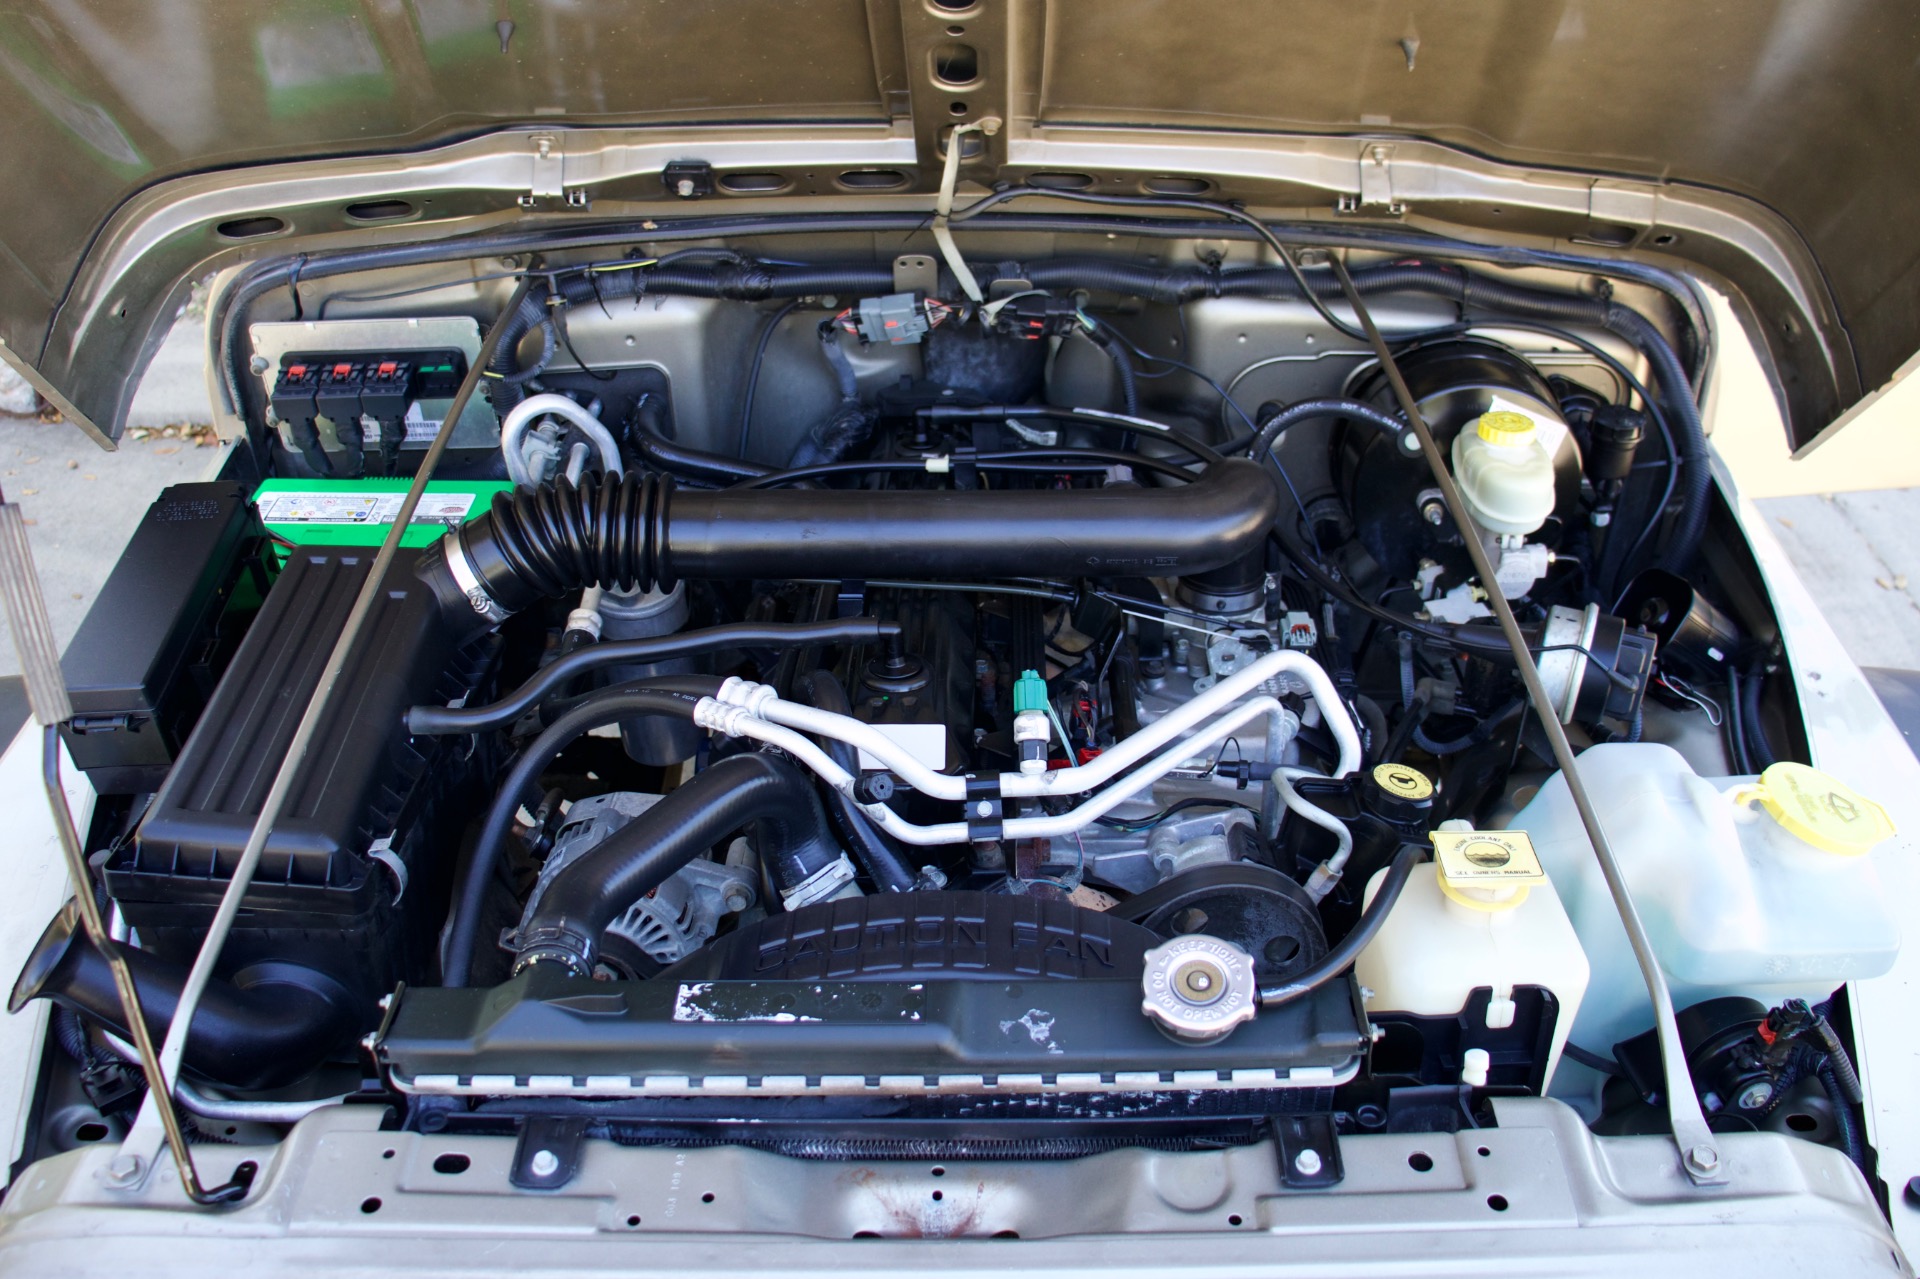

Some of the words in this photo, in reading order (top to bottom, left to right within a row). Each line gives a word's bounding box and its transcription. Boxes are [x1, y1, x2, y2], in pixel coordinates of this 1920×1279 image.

[755, 922, 987, 972] CAUTION
[1011, 926, 1115, 969] FAN
[1167, 941, 1206, 957] KEEP
[1209, 943, 1242, 969] TIGHT
[1152, 971, 1165, 989] DO
[1156, 991, 1181, 1013] NOT
[1220, 989, 1243, 1013] HOT
[1183, 1008, 1223, 1021] OPEN
